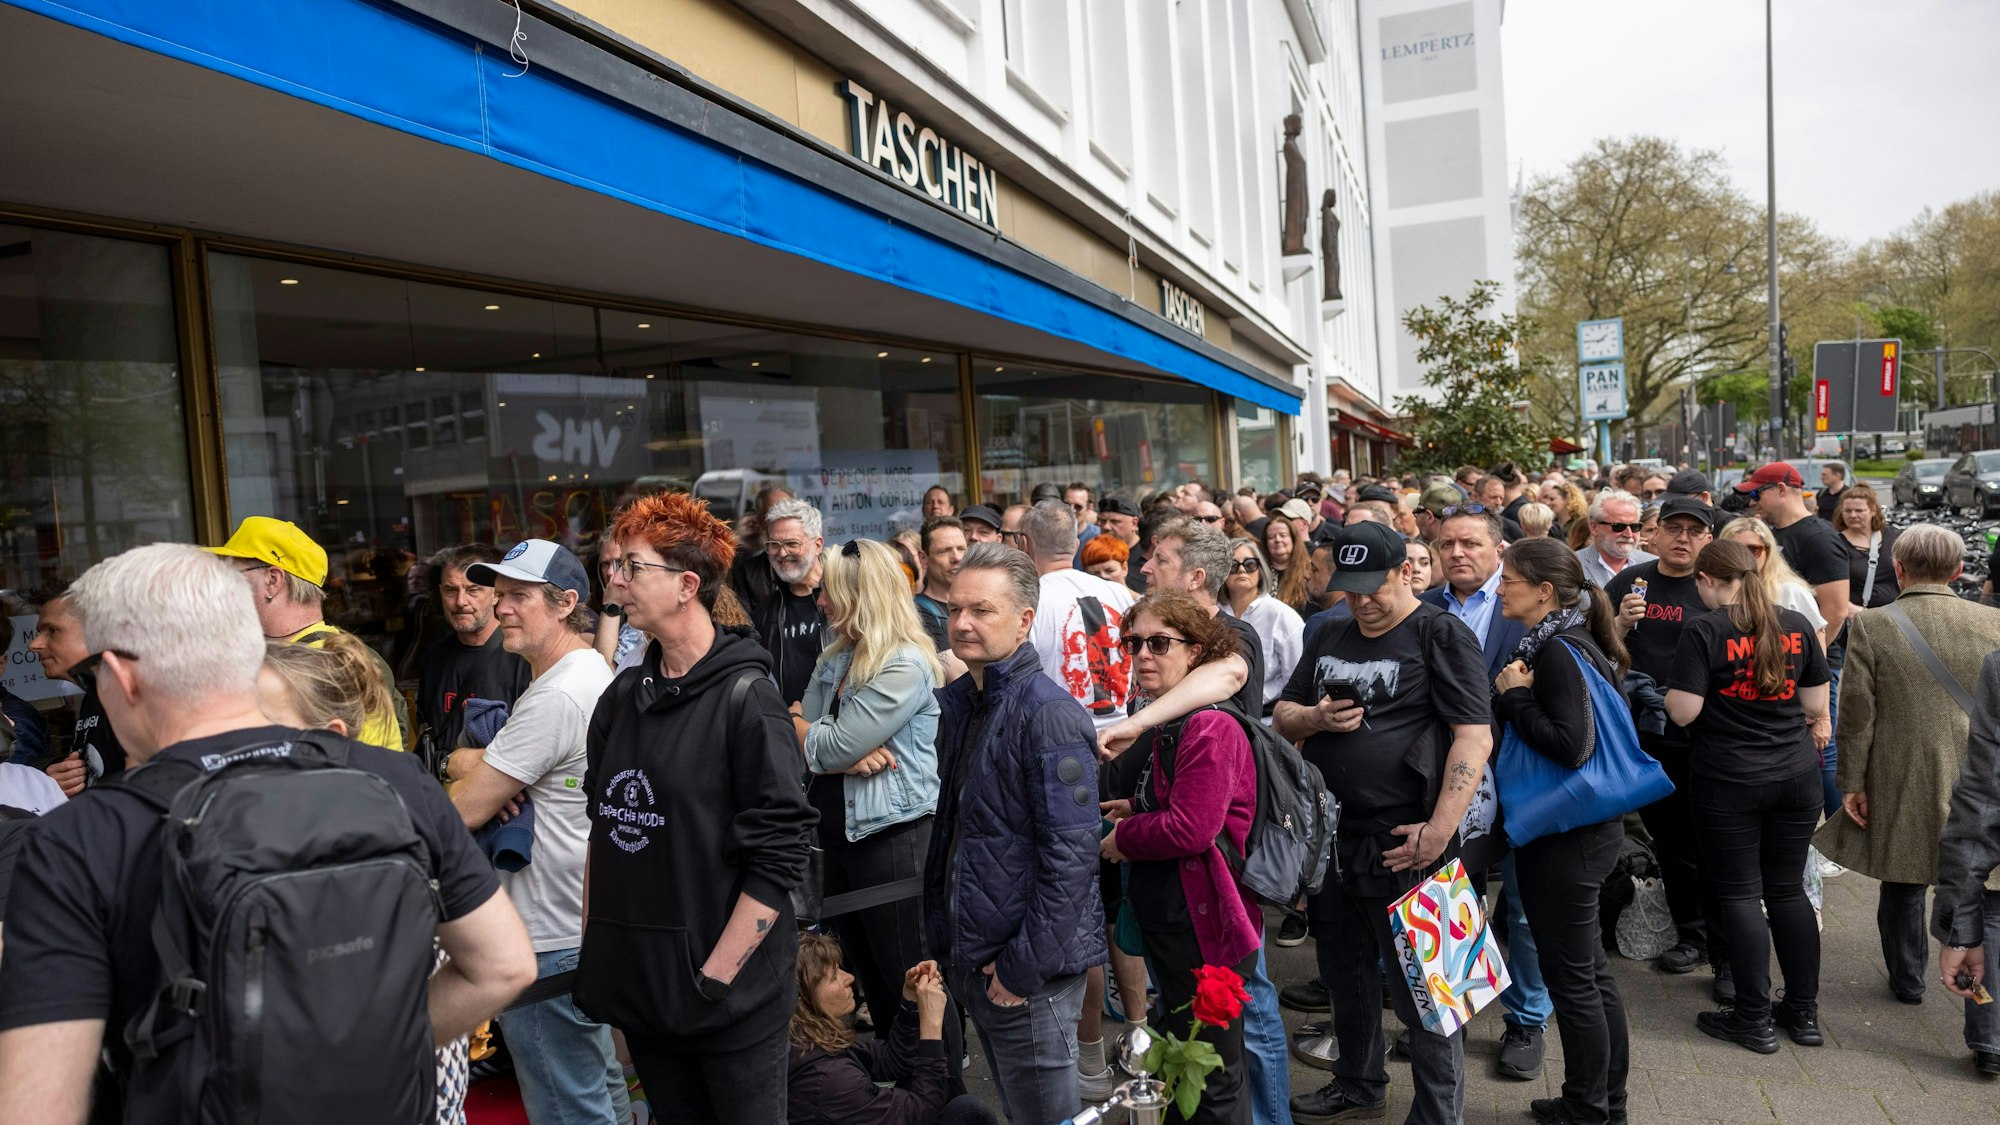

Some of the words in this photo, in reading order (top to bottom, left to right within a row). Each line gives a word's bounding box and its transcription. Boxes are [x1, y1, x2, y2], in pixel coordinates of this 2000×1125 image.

[1381, 32, 1476, 60] LEMPERTZ
[846, 79, 999, 230] TASCHEN
[1161, 278, 1206, 337] TASCHEN
[1586, 369, 1619, 384] PAN
[1586, 382, 1620, 392] KLINIK
[821, 467, 878, 487] DEPECHE
[884, 466, 914, 484] MODE
[831, 492, 873, 512] ANTON
[827, 525, 847, 537] Book
[851, 523, 883, 538] Signing
